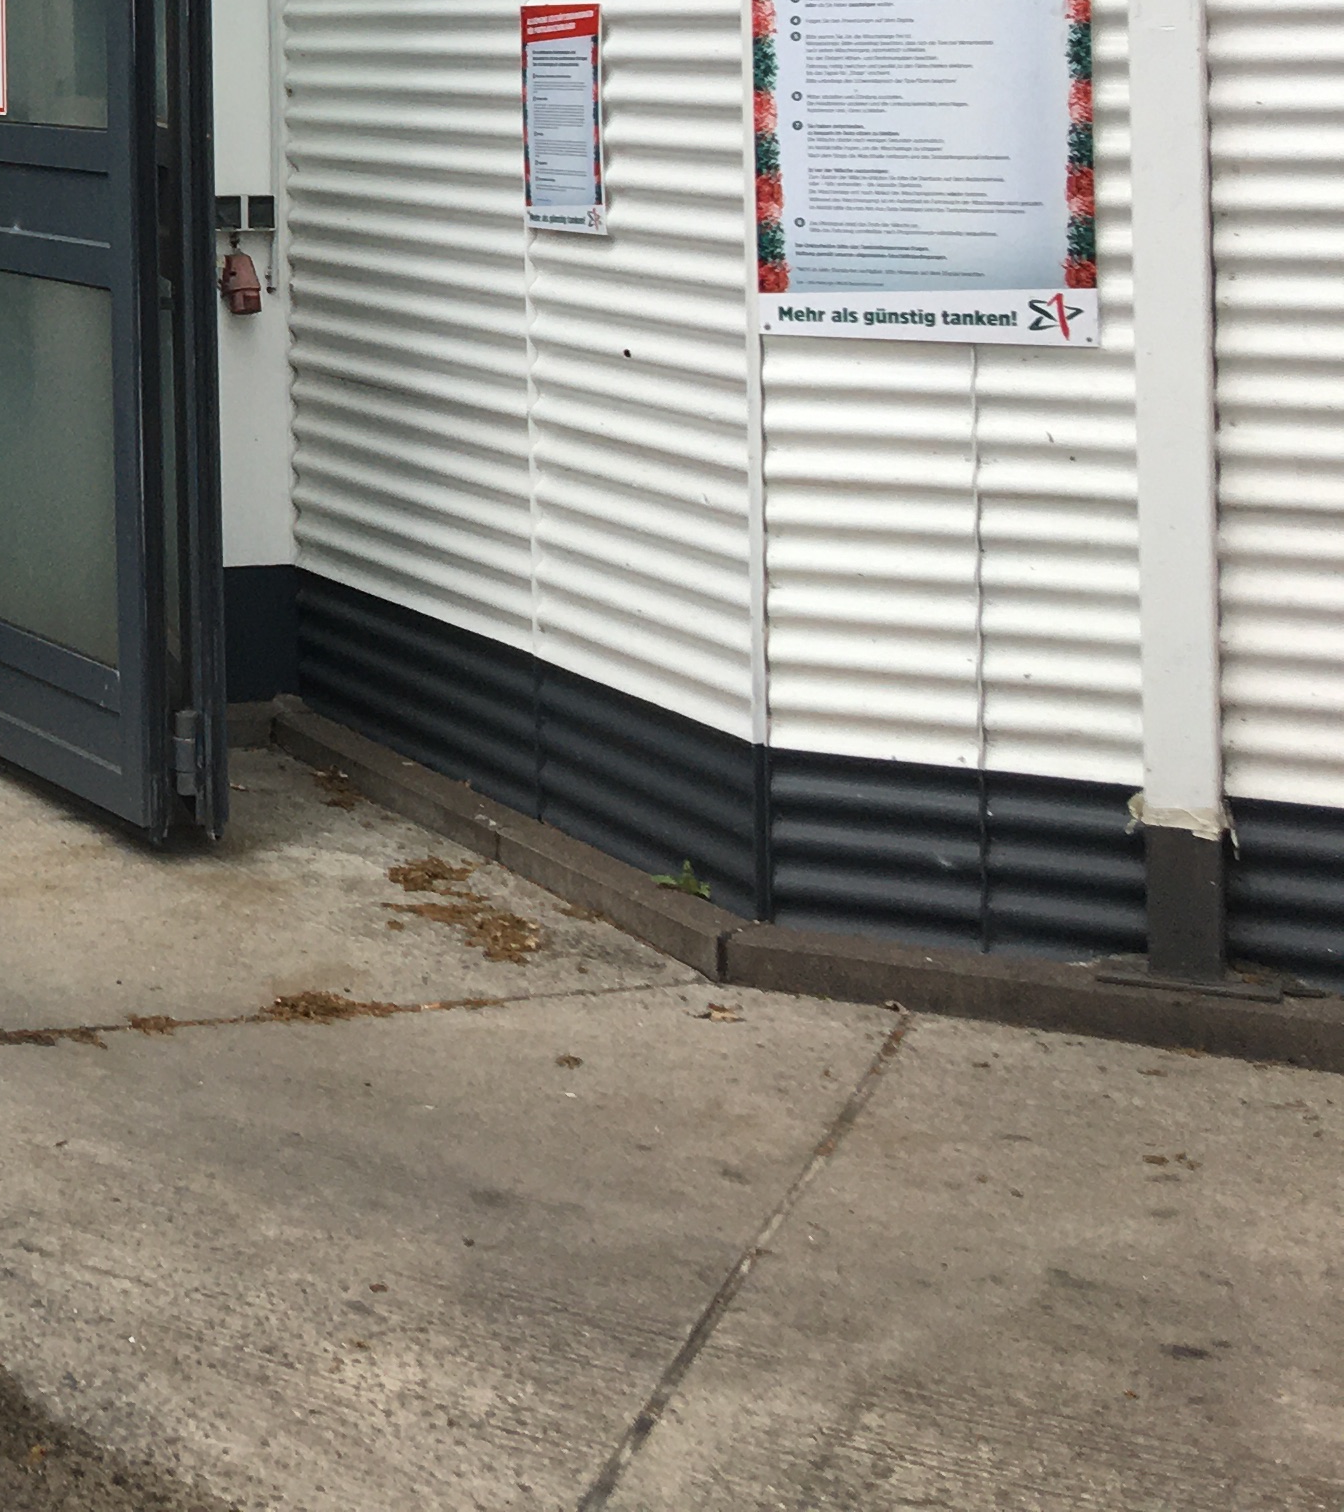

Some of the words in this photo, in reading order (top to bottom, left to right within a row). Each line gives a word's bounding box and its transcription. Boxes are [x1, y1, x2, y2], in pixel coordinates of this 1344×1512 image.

[778, 306, 824, 323] Mehr
[831, 308, 859, 324] als
[863, 308, 936, 327] günstig
[942, 310, 1018, 327] tanken!
